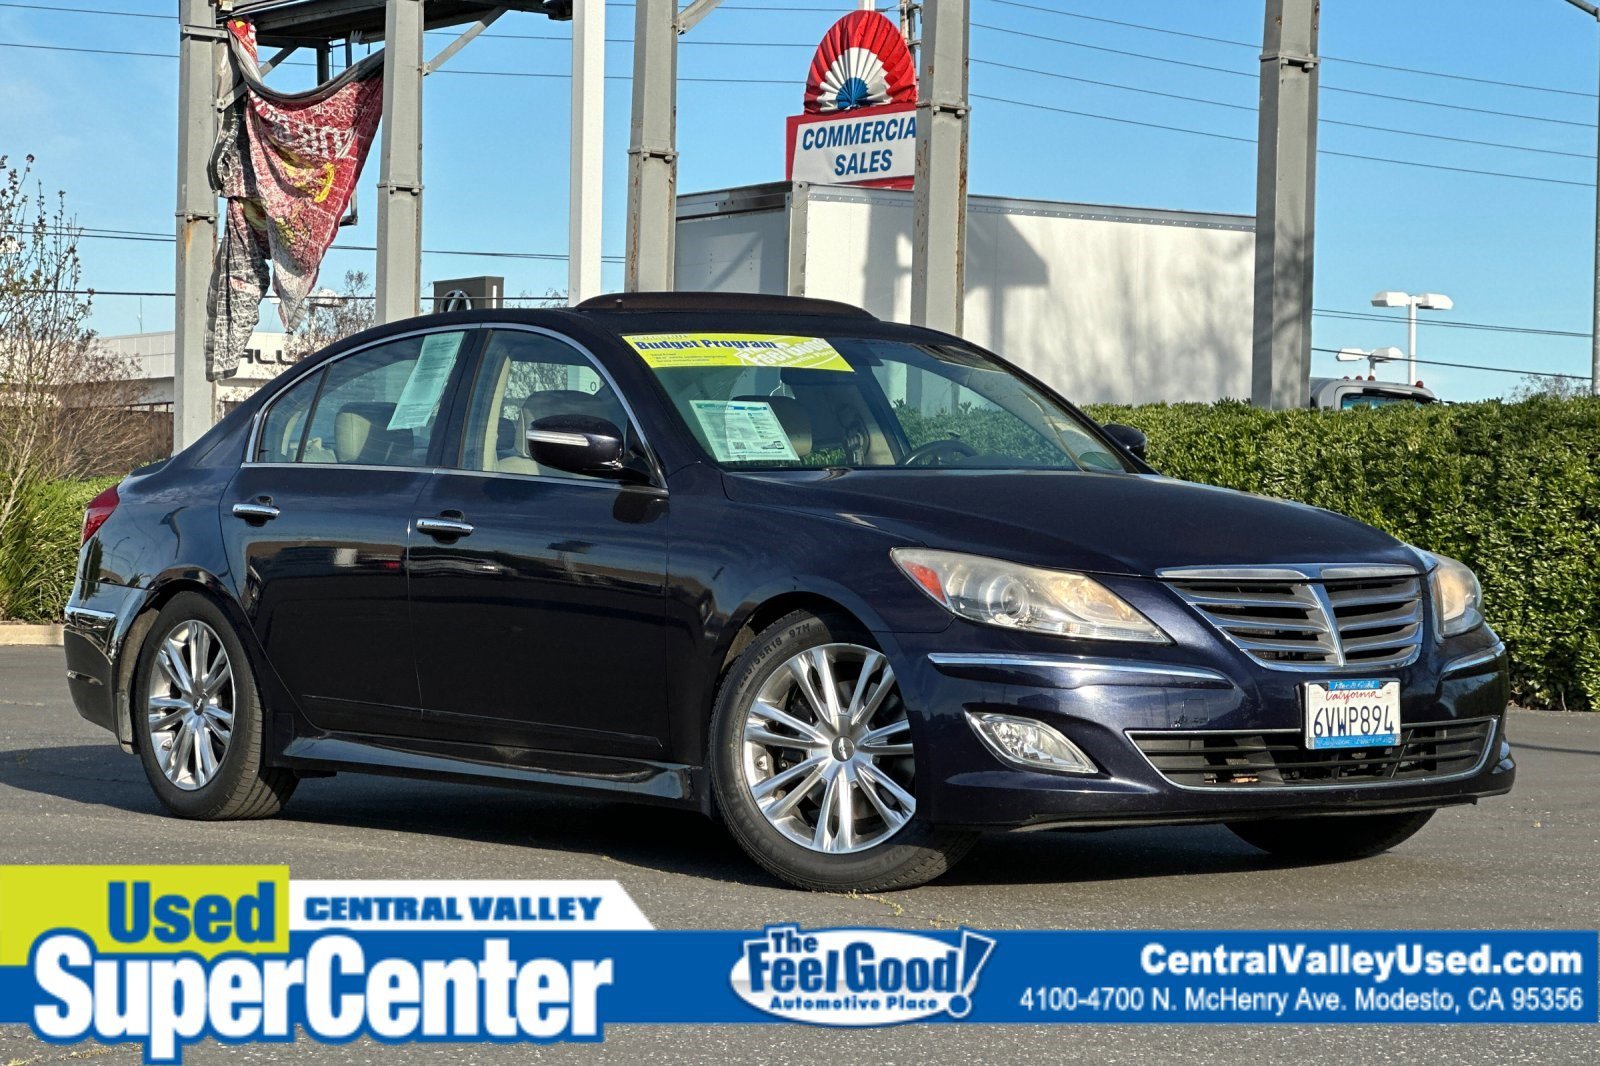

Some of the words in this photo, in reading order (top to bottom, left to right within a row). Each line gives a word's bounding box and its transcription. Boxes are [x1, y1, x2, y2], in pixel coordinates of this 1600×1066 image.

[802, 117, 917, 151] COMMERCIA
[834, 149, 893, 176] SALES
[635, 338, 700, 350] Budget
[704, 338, 777, 350] Program
[1325, 690, 1383, 704] California
[1313, 705, 1395, 737] 6VWP894
